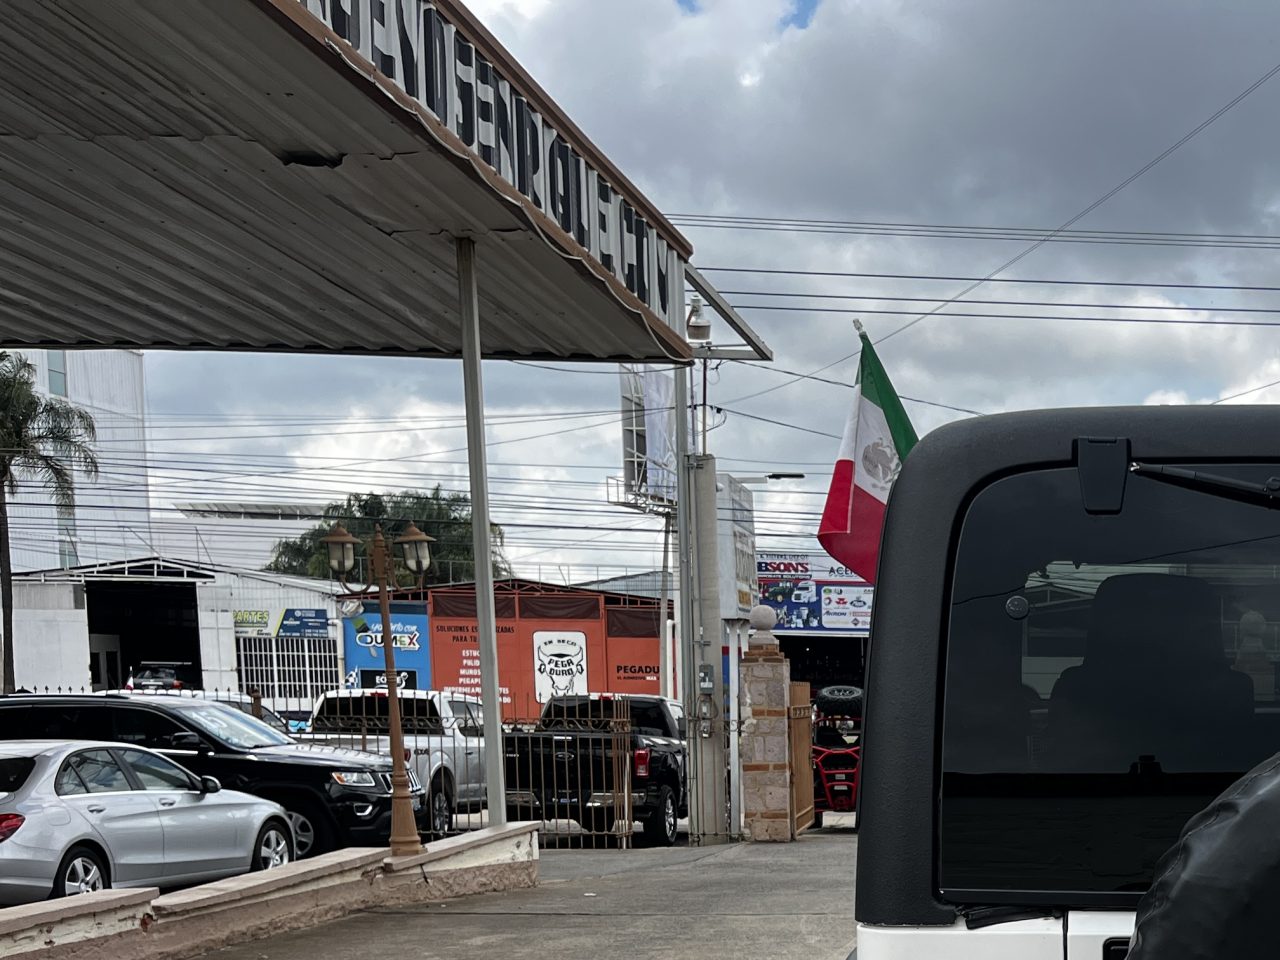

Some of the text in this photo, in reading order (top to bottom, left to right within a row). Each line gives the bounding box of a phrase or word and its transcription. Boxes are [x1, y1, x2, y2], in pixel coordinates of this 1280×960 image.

[436, 625, 469, 633] SOLUCIONES
[547, 658, 575, 668] PEGA
[549, 668, 574, 676] DURO
